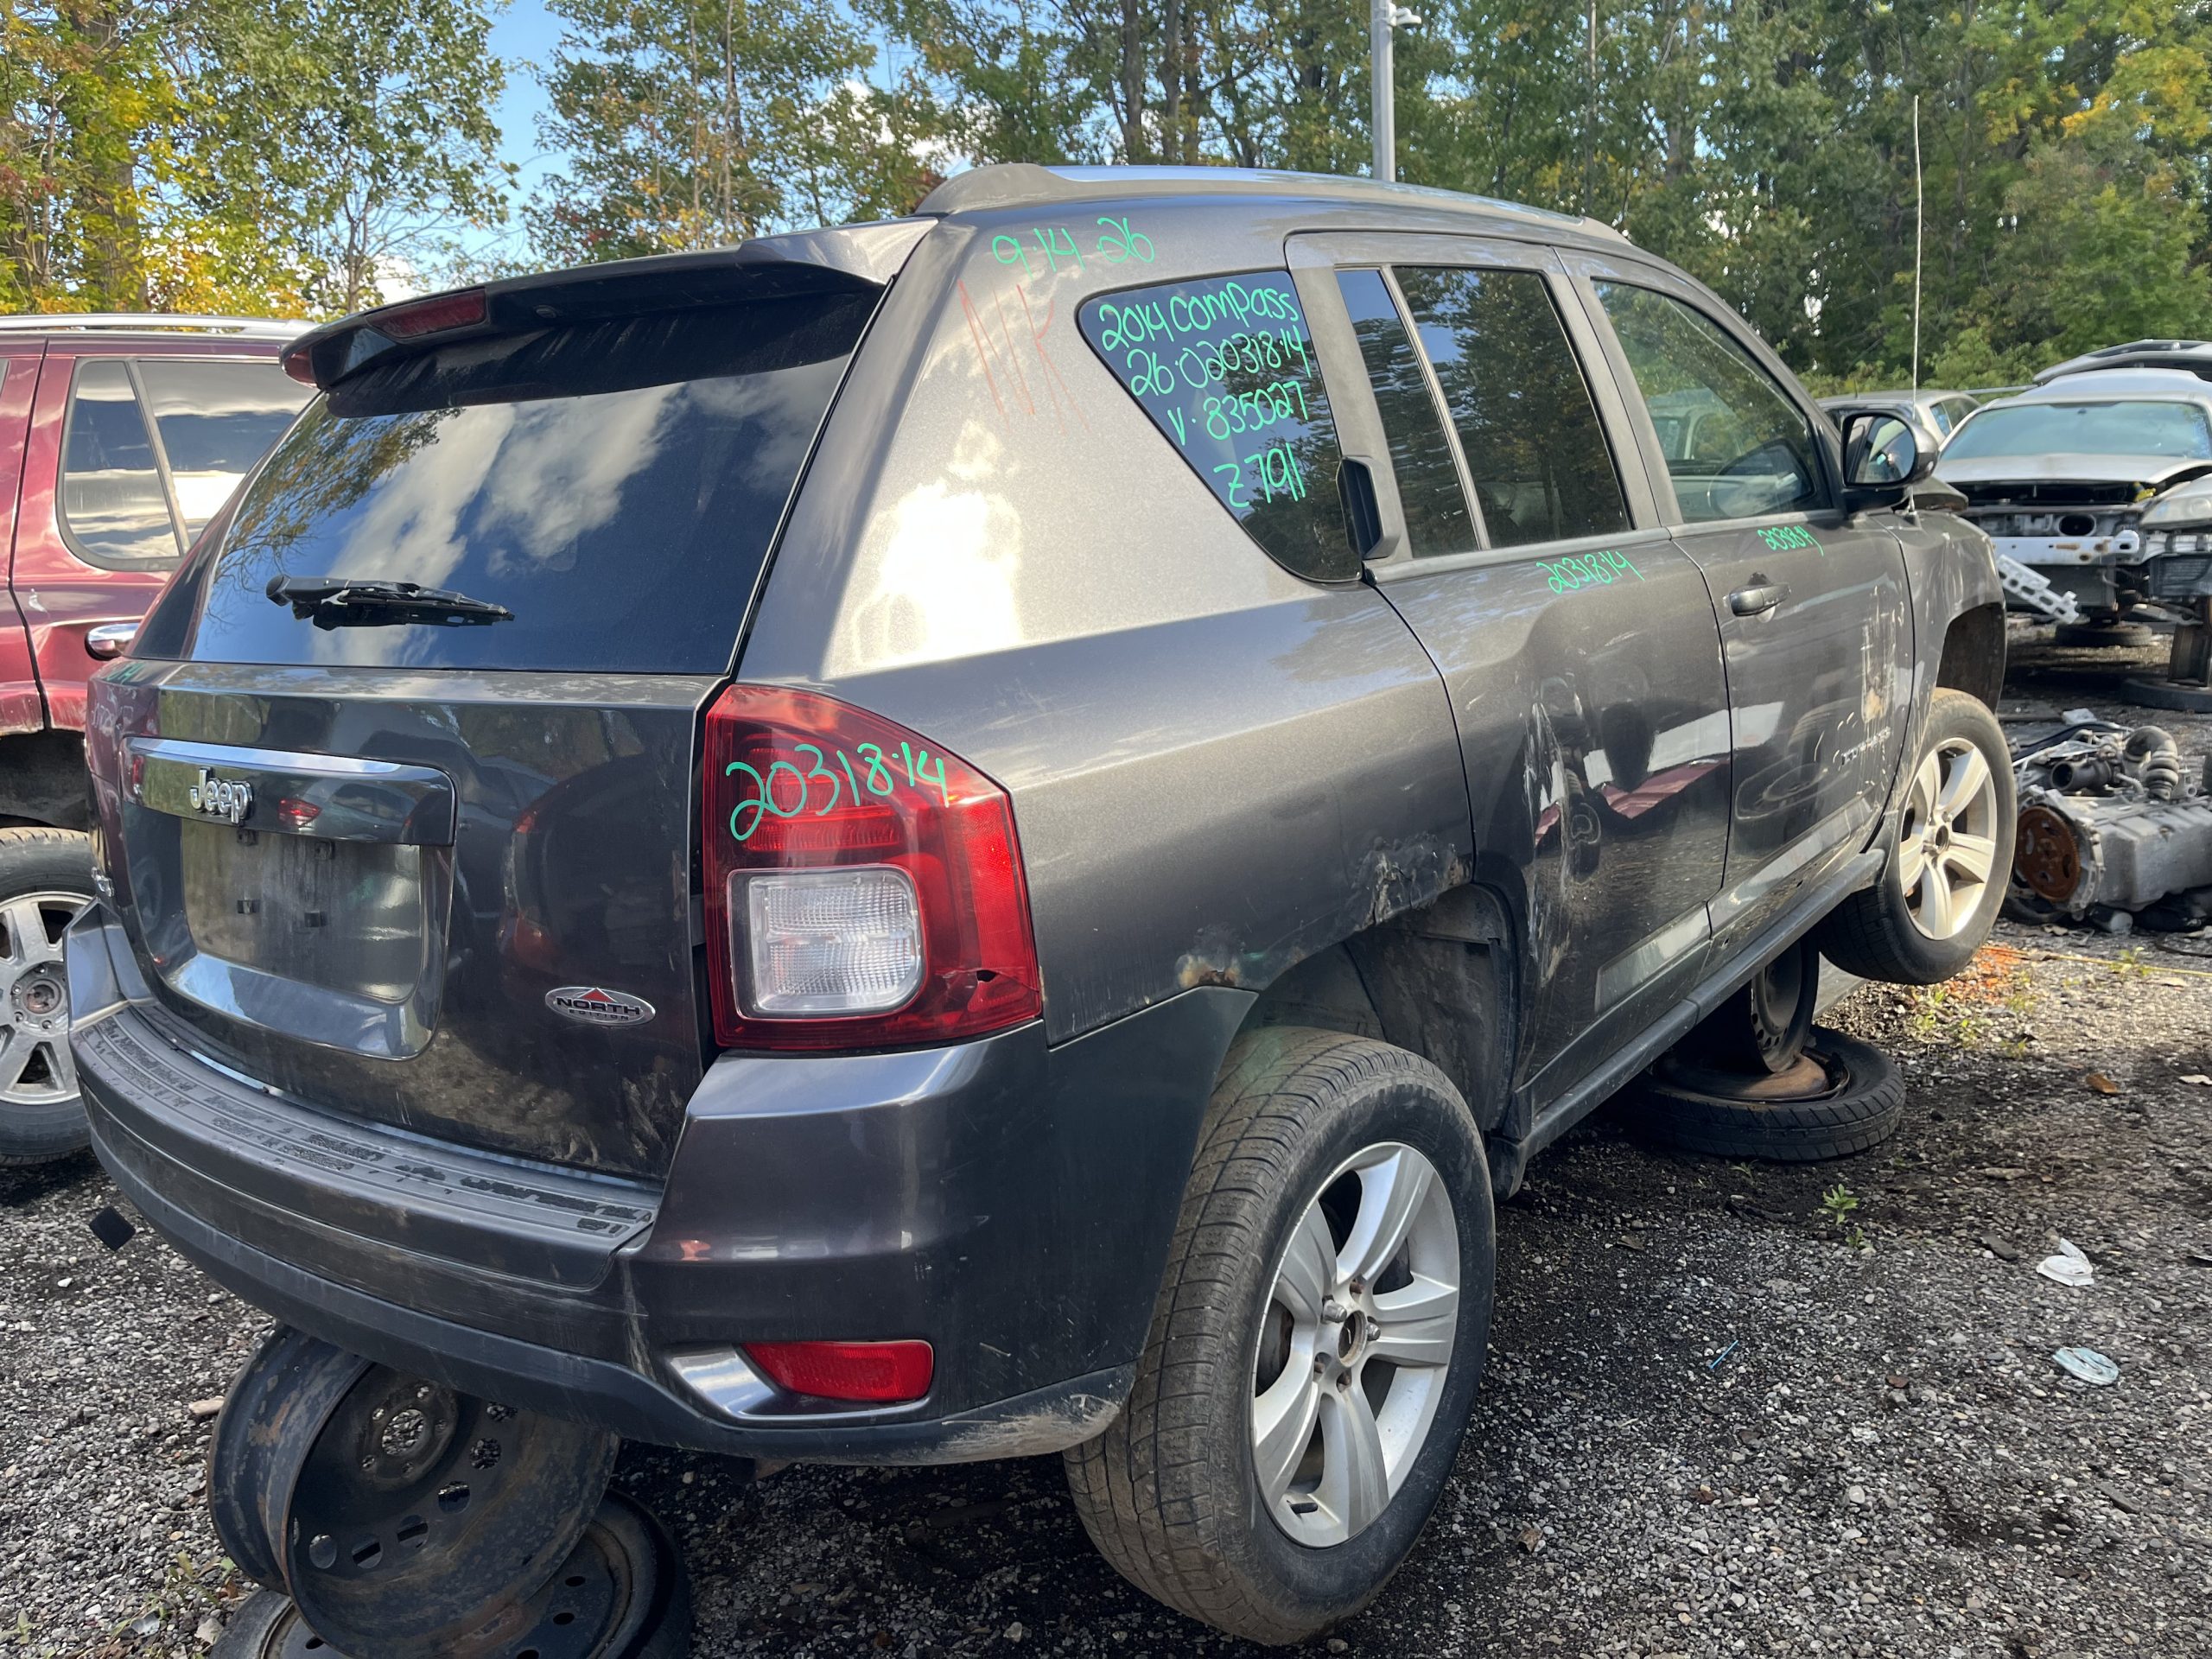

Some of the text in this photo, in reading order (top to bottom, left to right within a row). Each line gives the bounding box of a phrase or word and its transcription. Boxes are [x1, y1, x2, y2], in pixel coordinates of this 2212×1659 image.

[1098, 301, 1175, 352] 2014
[189, 766, 255, 825] Jeep
[556, 996, 641, 1015] NORTH
[569, 1009, 630, 1020] EDITION
